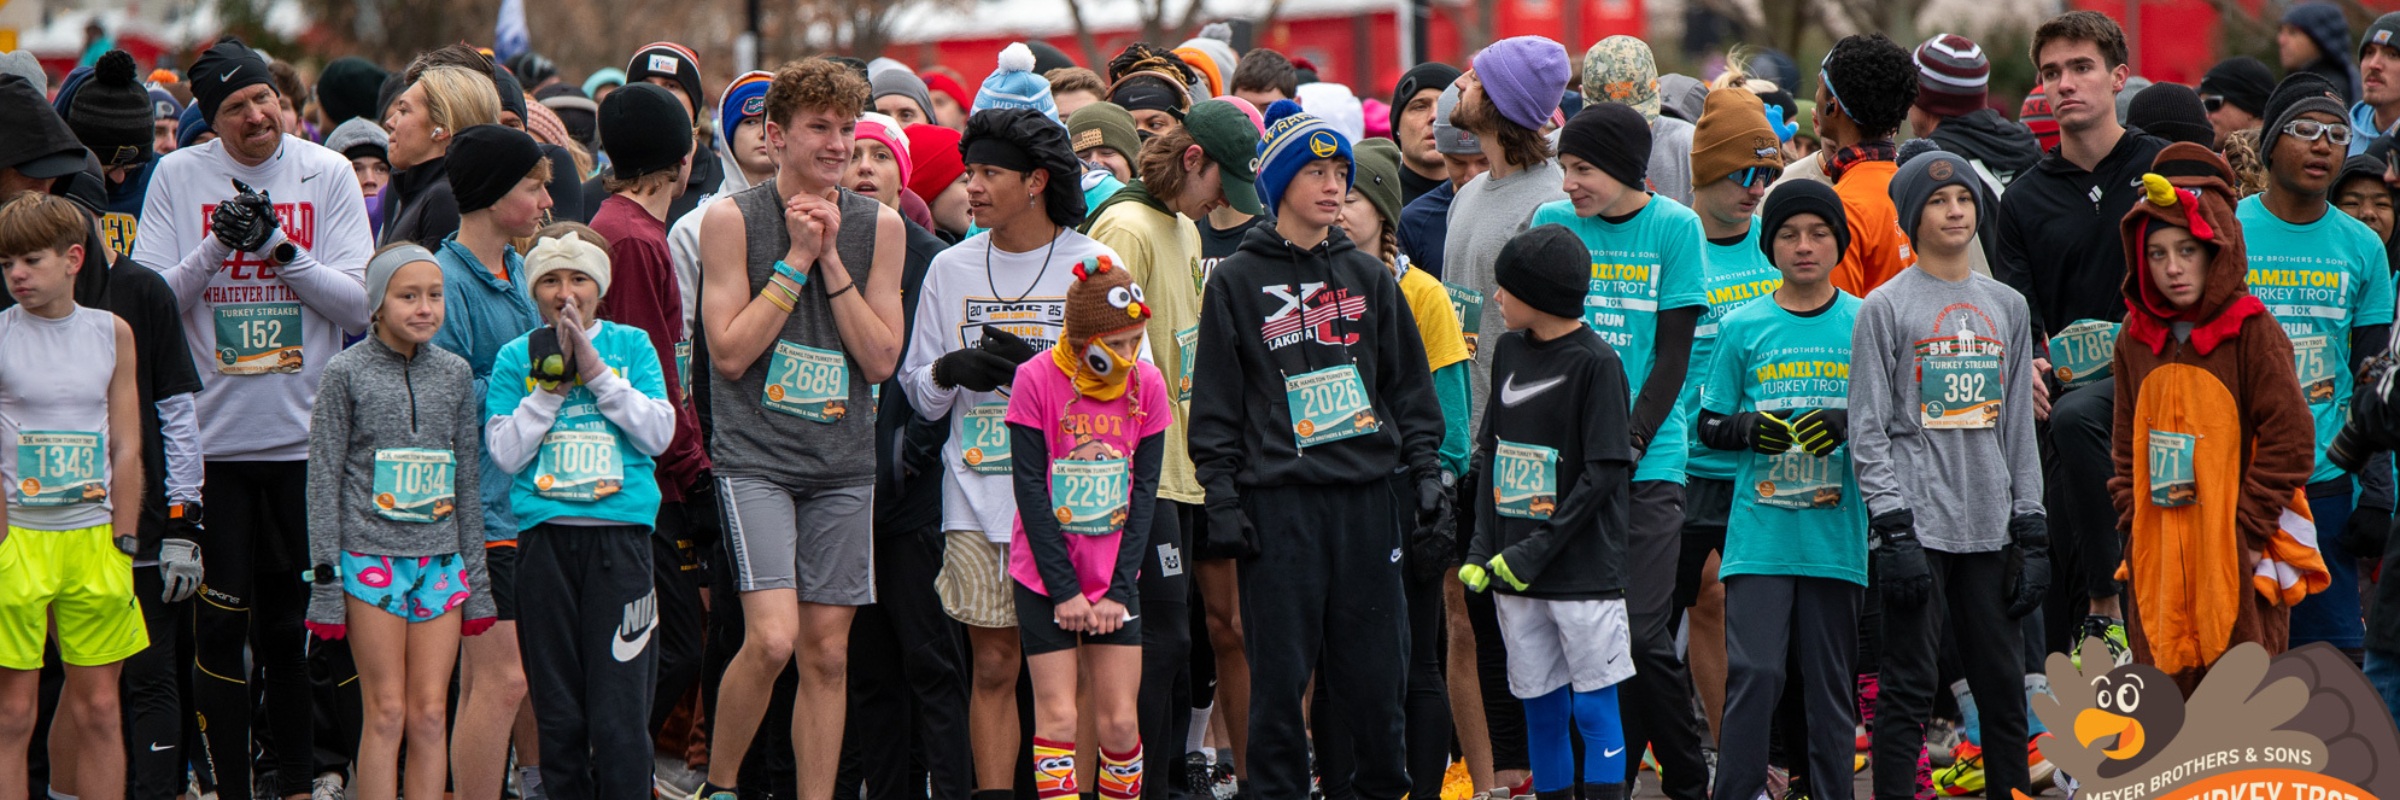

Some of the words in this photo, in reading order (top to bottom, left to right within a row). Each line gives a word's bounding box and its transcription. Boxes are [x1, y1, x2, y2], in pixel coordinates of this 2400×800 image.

[2267, 255, 2312, 263] BROTHERS
[2325, 257, 2348, 267] SONS
[204, 285, 263, 303] WHATEVER
[266, 285, 276, 302] IT
[1612, 281, 1646, 295] TROT
[2299, 288, 2336, 302] TROT
[221, 308, 255, 318] TURKEY
[257, 307, 299, 316] STREAKER
[970, 304, 981, 317] 20
[985, 304, 1042, 313] GMC
[1048, 304, 1062, 317] 25
[1594, 312, 1625, 328] RUN
[2291, 306, 2311, 315] 10K
[238, 319, 282, 349] 152
[2281, 322, 2313, 336] RUN
[1269, 329, 1314, 351] LAKOTA
[1929, 341, 1952, 356] 5K
[2060, 330, 2114, 365] 1786
[1756, 361, 1849, 383] HAMILTON
[1930, 360, 1963, 369] TURKEY
[1964, 360, 1998, 369] STREAKER
[780, 358, 842, 396] 2689
[1762, 379, 1809, 395] TURKEY
[1812, 378, 1846, 393] TROT
[1944, 373, 1986, 402] 392
[1301, 379, 1361, 418] 2026
[1805, 398, 1823, 406] 10K
[976, 416, 1006, 447] 25
[34, 445, 94, 479] 1343
[551, 442, 612, 475] 1008
[392, 462, 447, 495] 1034
[1056, 466, 1066, 474] 5K
[1500, 457, 1545, 491] 1423
[1768, 454, 1829, 484] 2601
[1065, 475, 1122, 508] 2294
